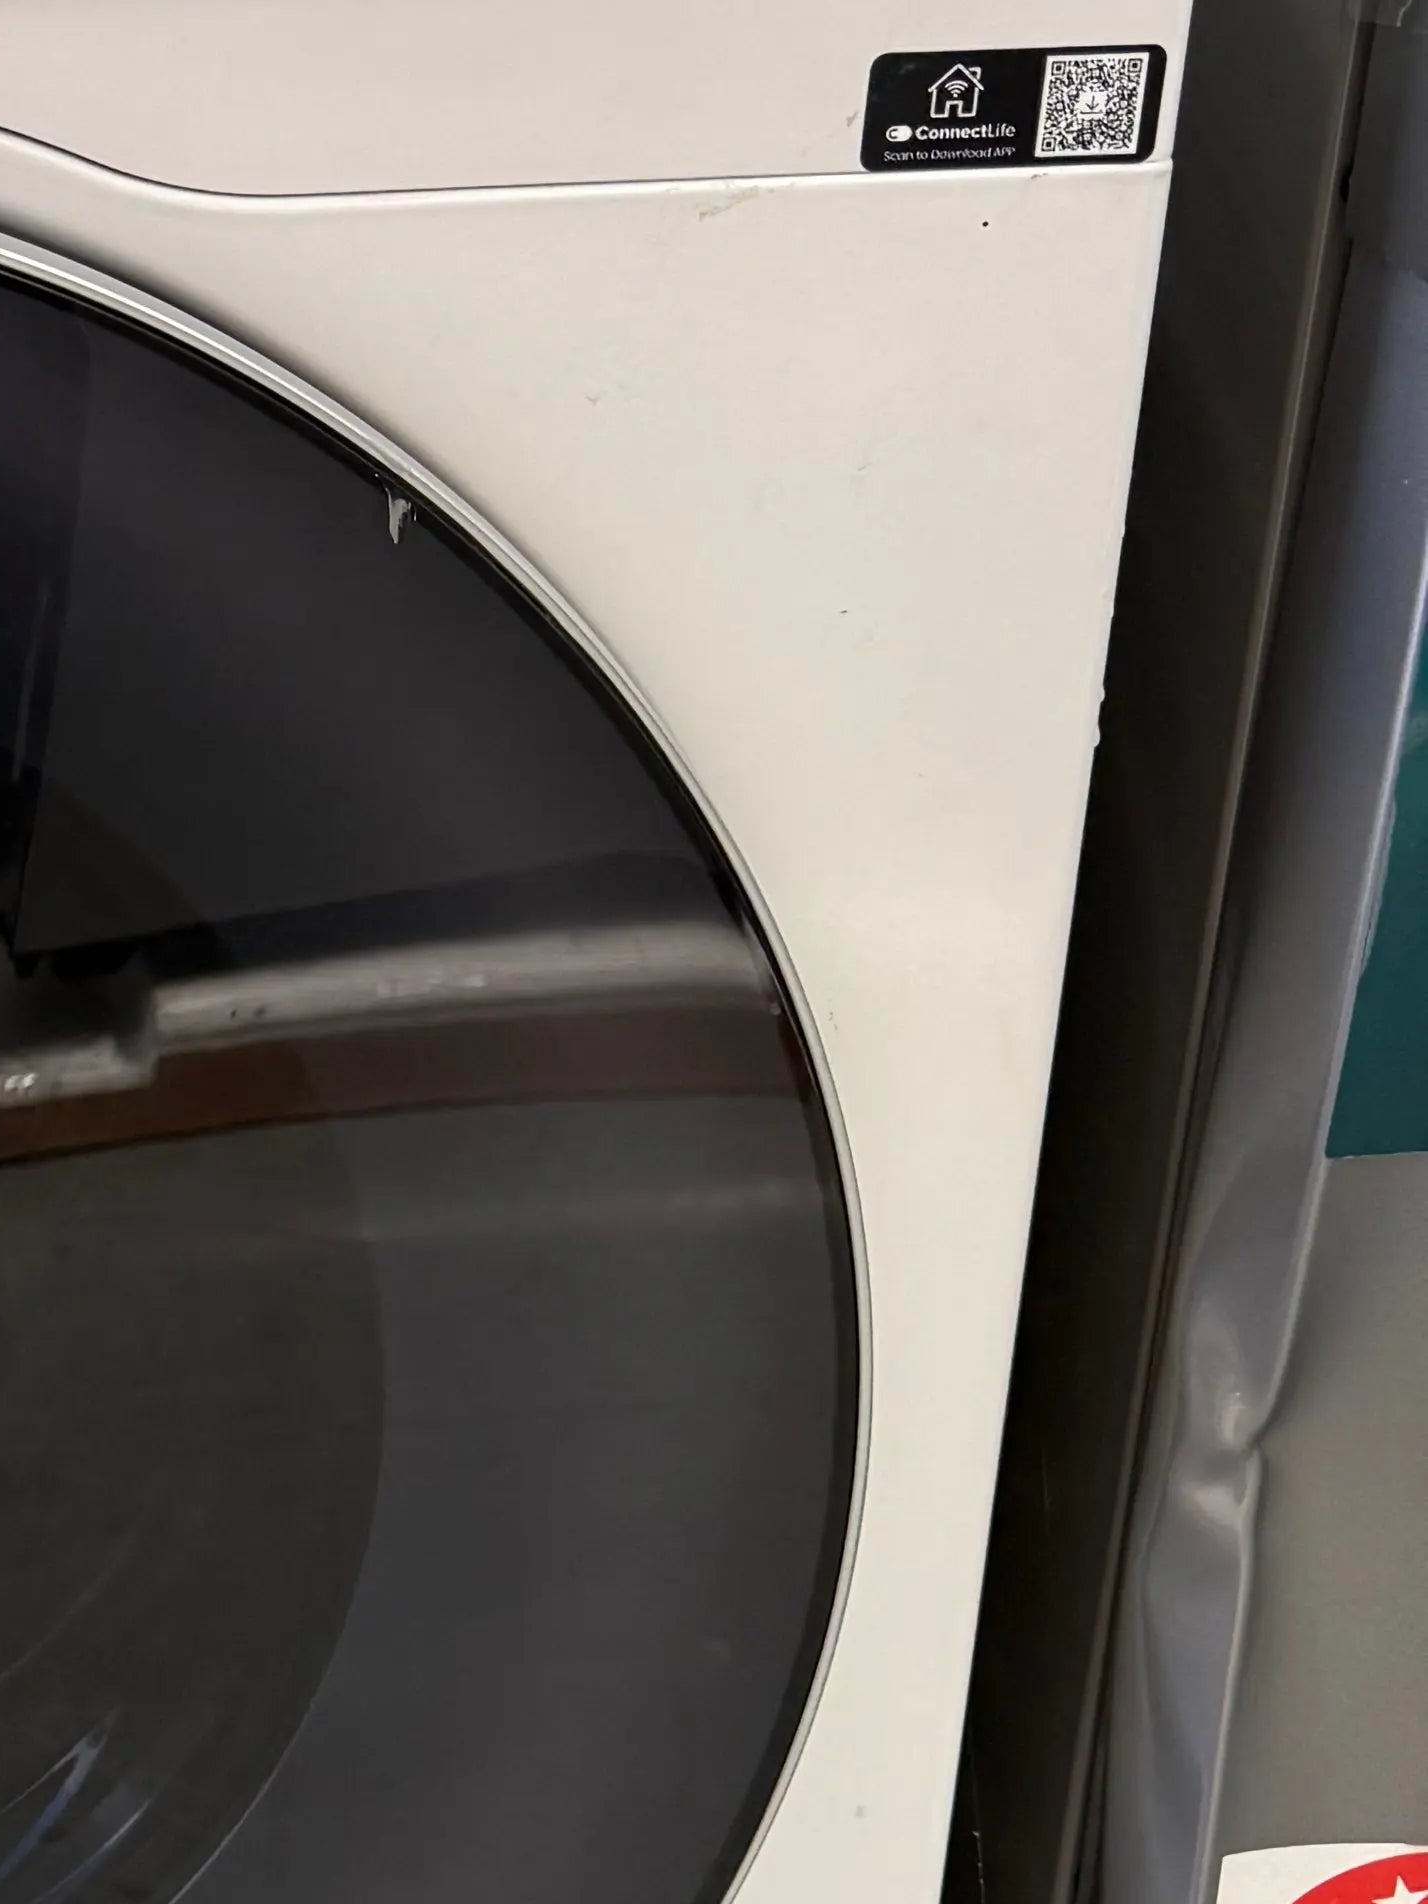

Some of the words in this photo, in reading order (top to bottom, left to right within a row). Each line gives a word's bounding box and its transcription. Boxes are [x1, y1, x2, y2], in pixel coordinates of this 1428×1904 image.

[915, 123, 1016, 140] ConnectLife
[884, 150, 914, 162] Scan
[917, 150, 928, 160] to
[931, 147, 991, 160] Download
